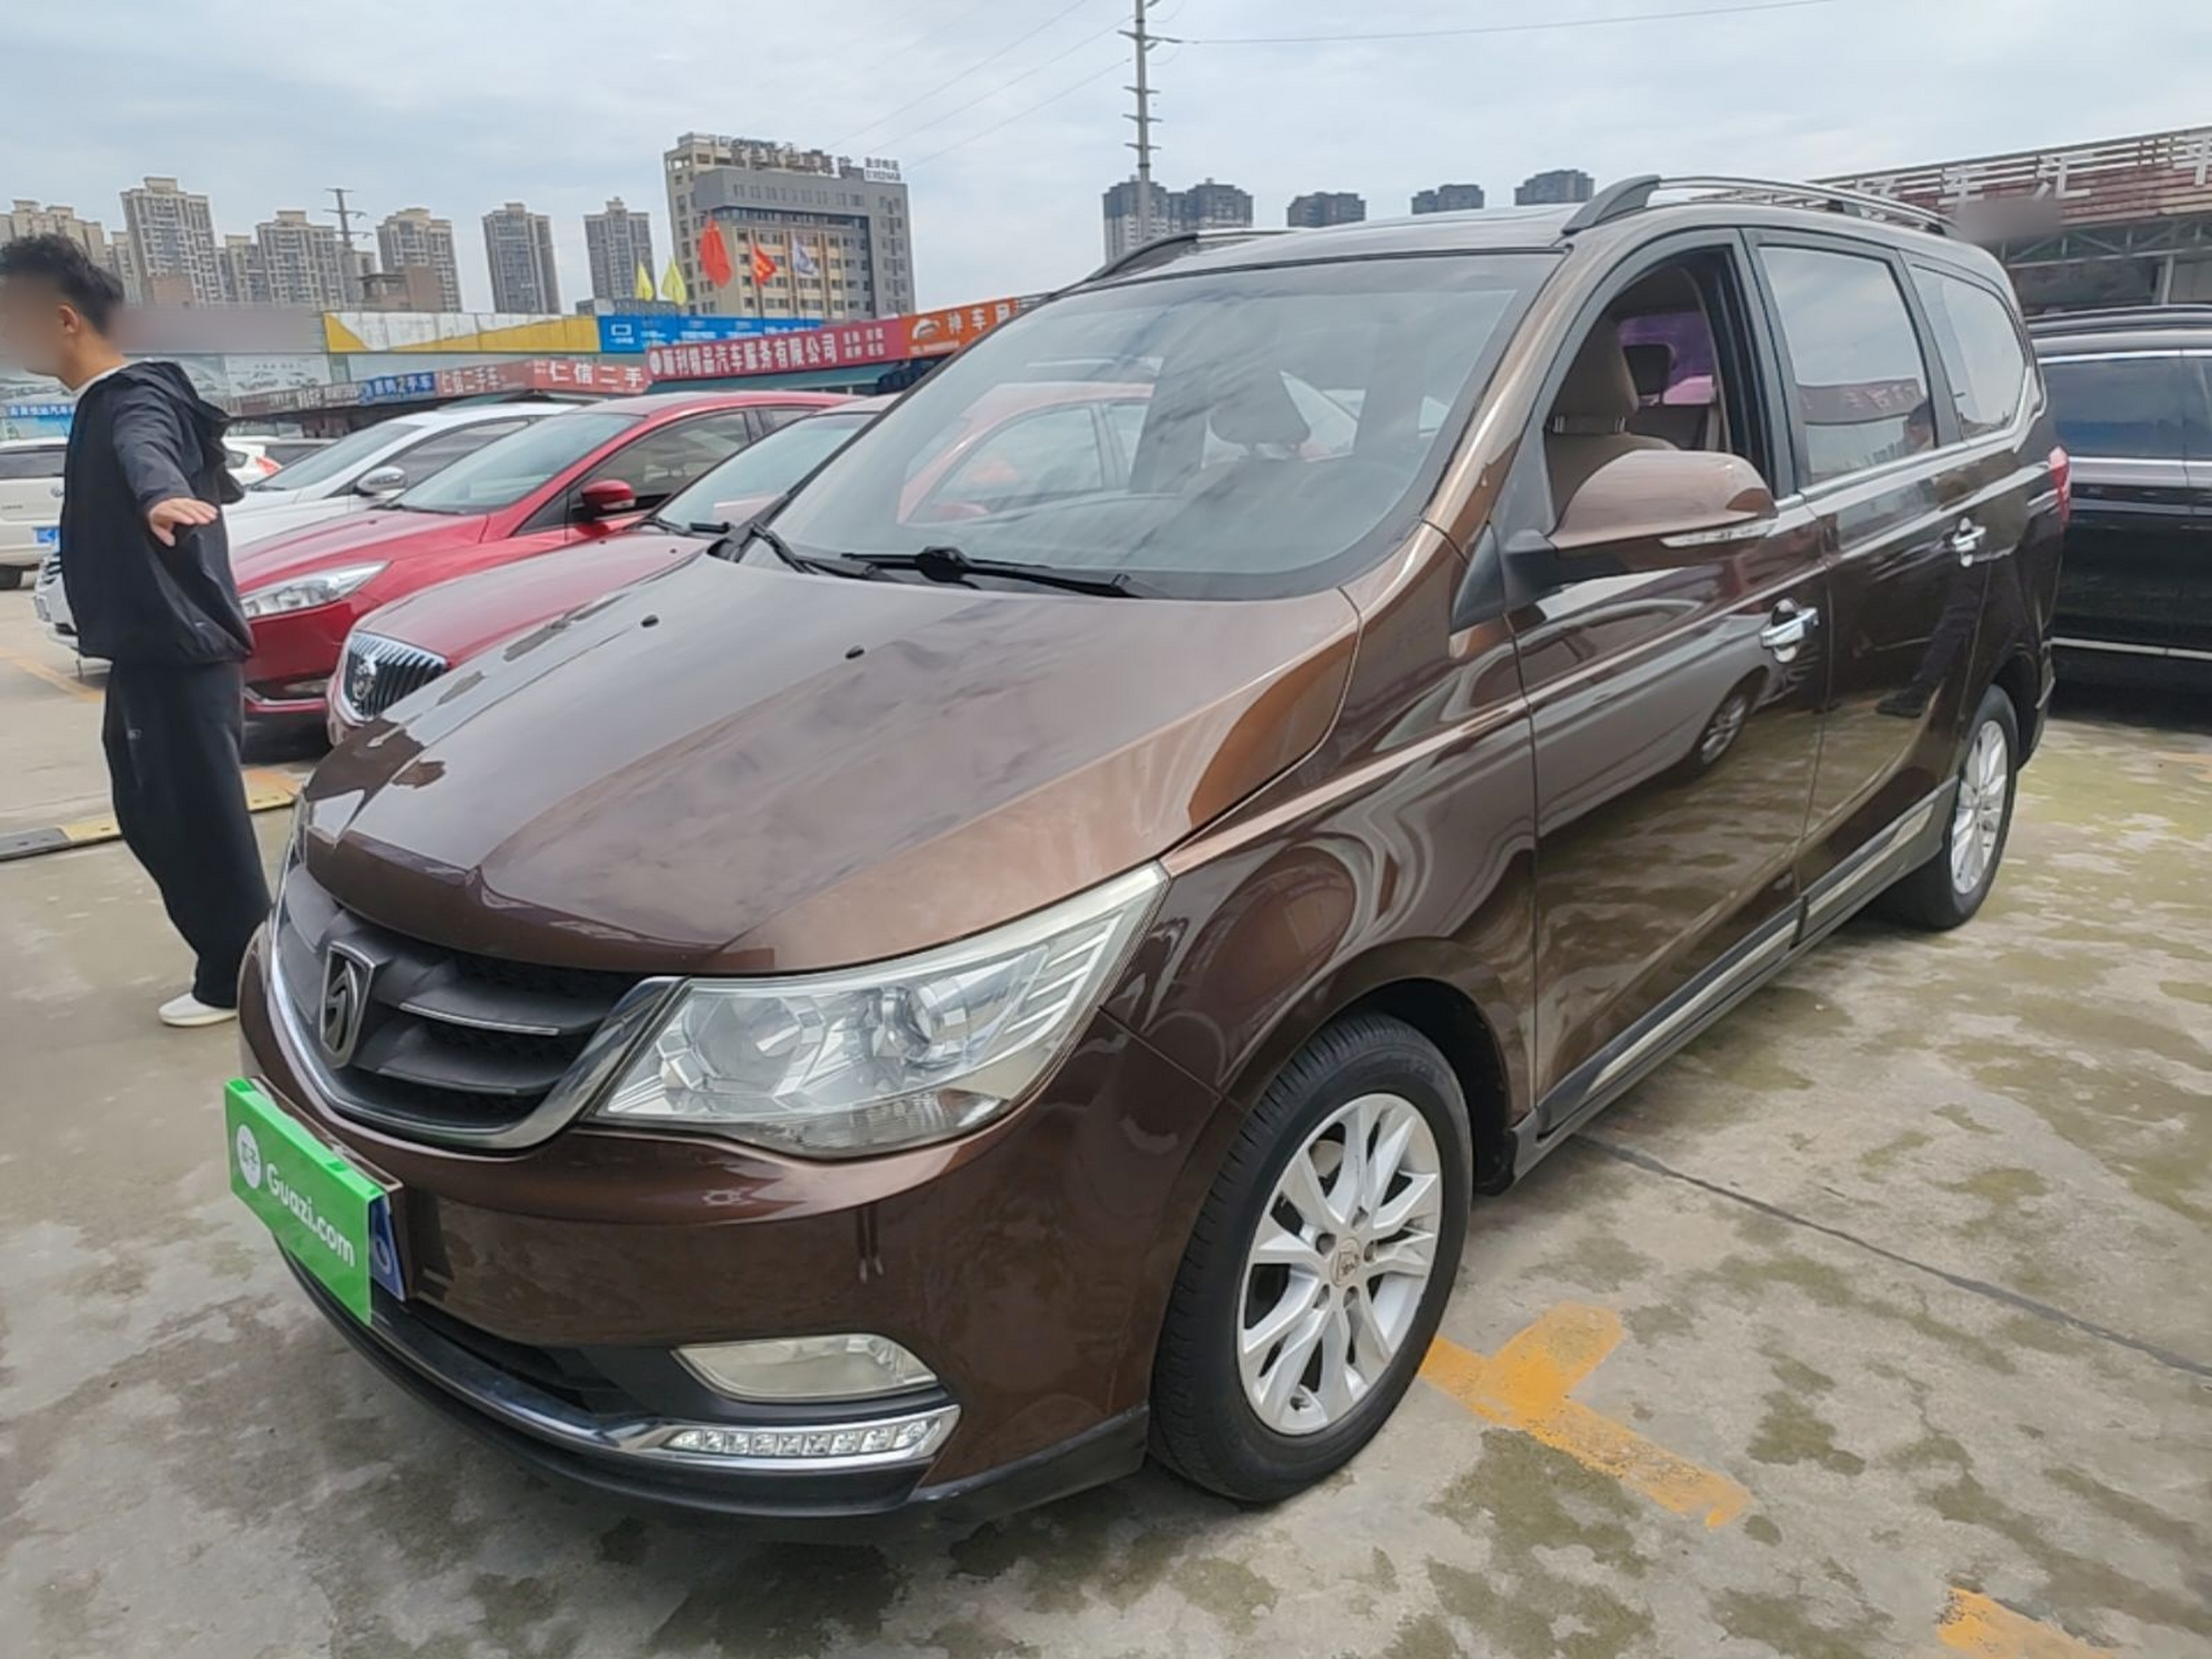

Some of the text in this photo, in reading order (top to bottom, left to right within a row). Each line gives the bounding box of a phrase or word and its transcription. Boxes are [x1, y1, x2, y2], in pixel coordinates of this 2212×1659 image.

[548, 361, 644, 388] 仁信二手
[267, 1163, 355, 1268] Guazi.com
